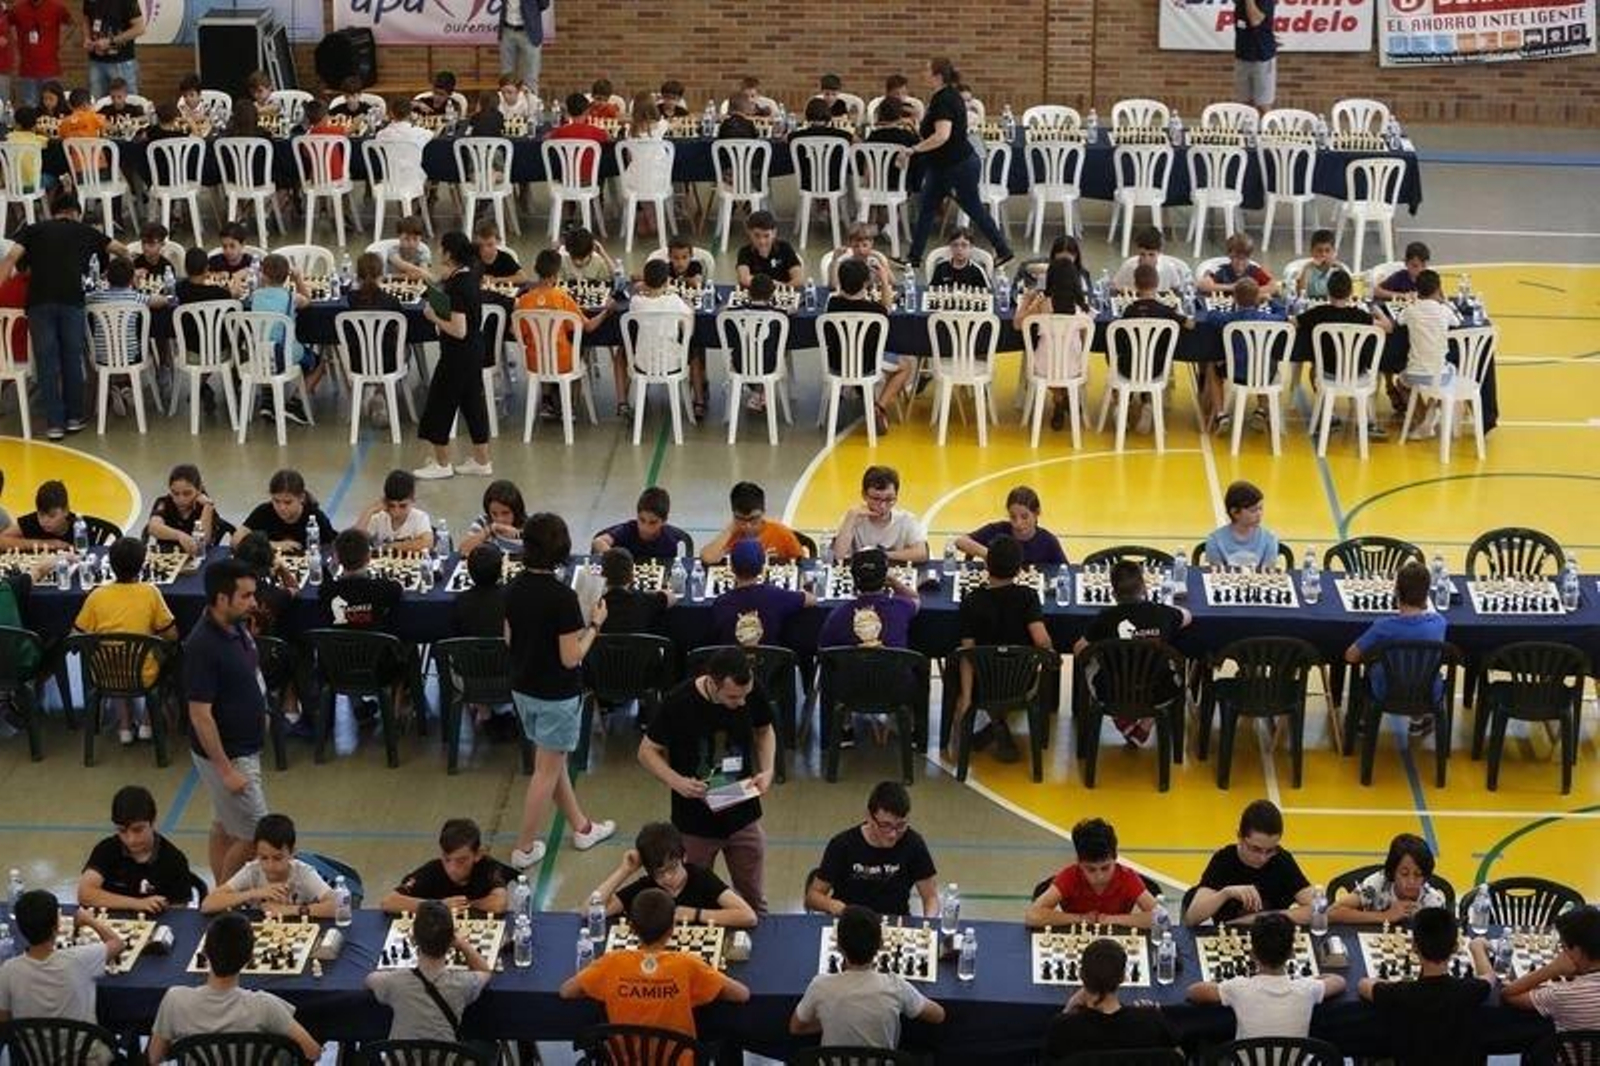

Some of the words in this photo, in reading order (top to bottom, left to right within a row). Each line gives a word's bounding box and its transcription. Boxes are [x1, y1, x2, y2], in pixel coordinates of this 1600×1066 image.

[1215, 11, 1358, 32] Padelo
[1387, 20, 1406, 32] EL
[1411, 16, 1476, 32] AHORRO
[1483, 6, 1587, 28] INTELIGENTE
